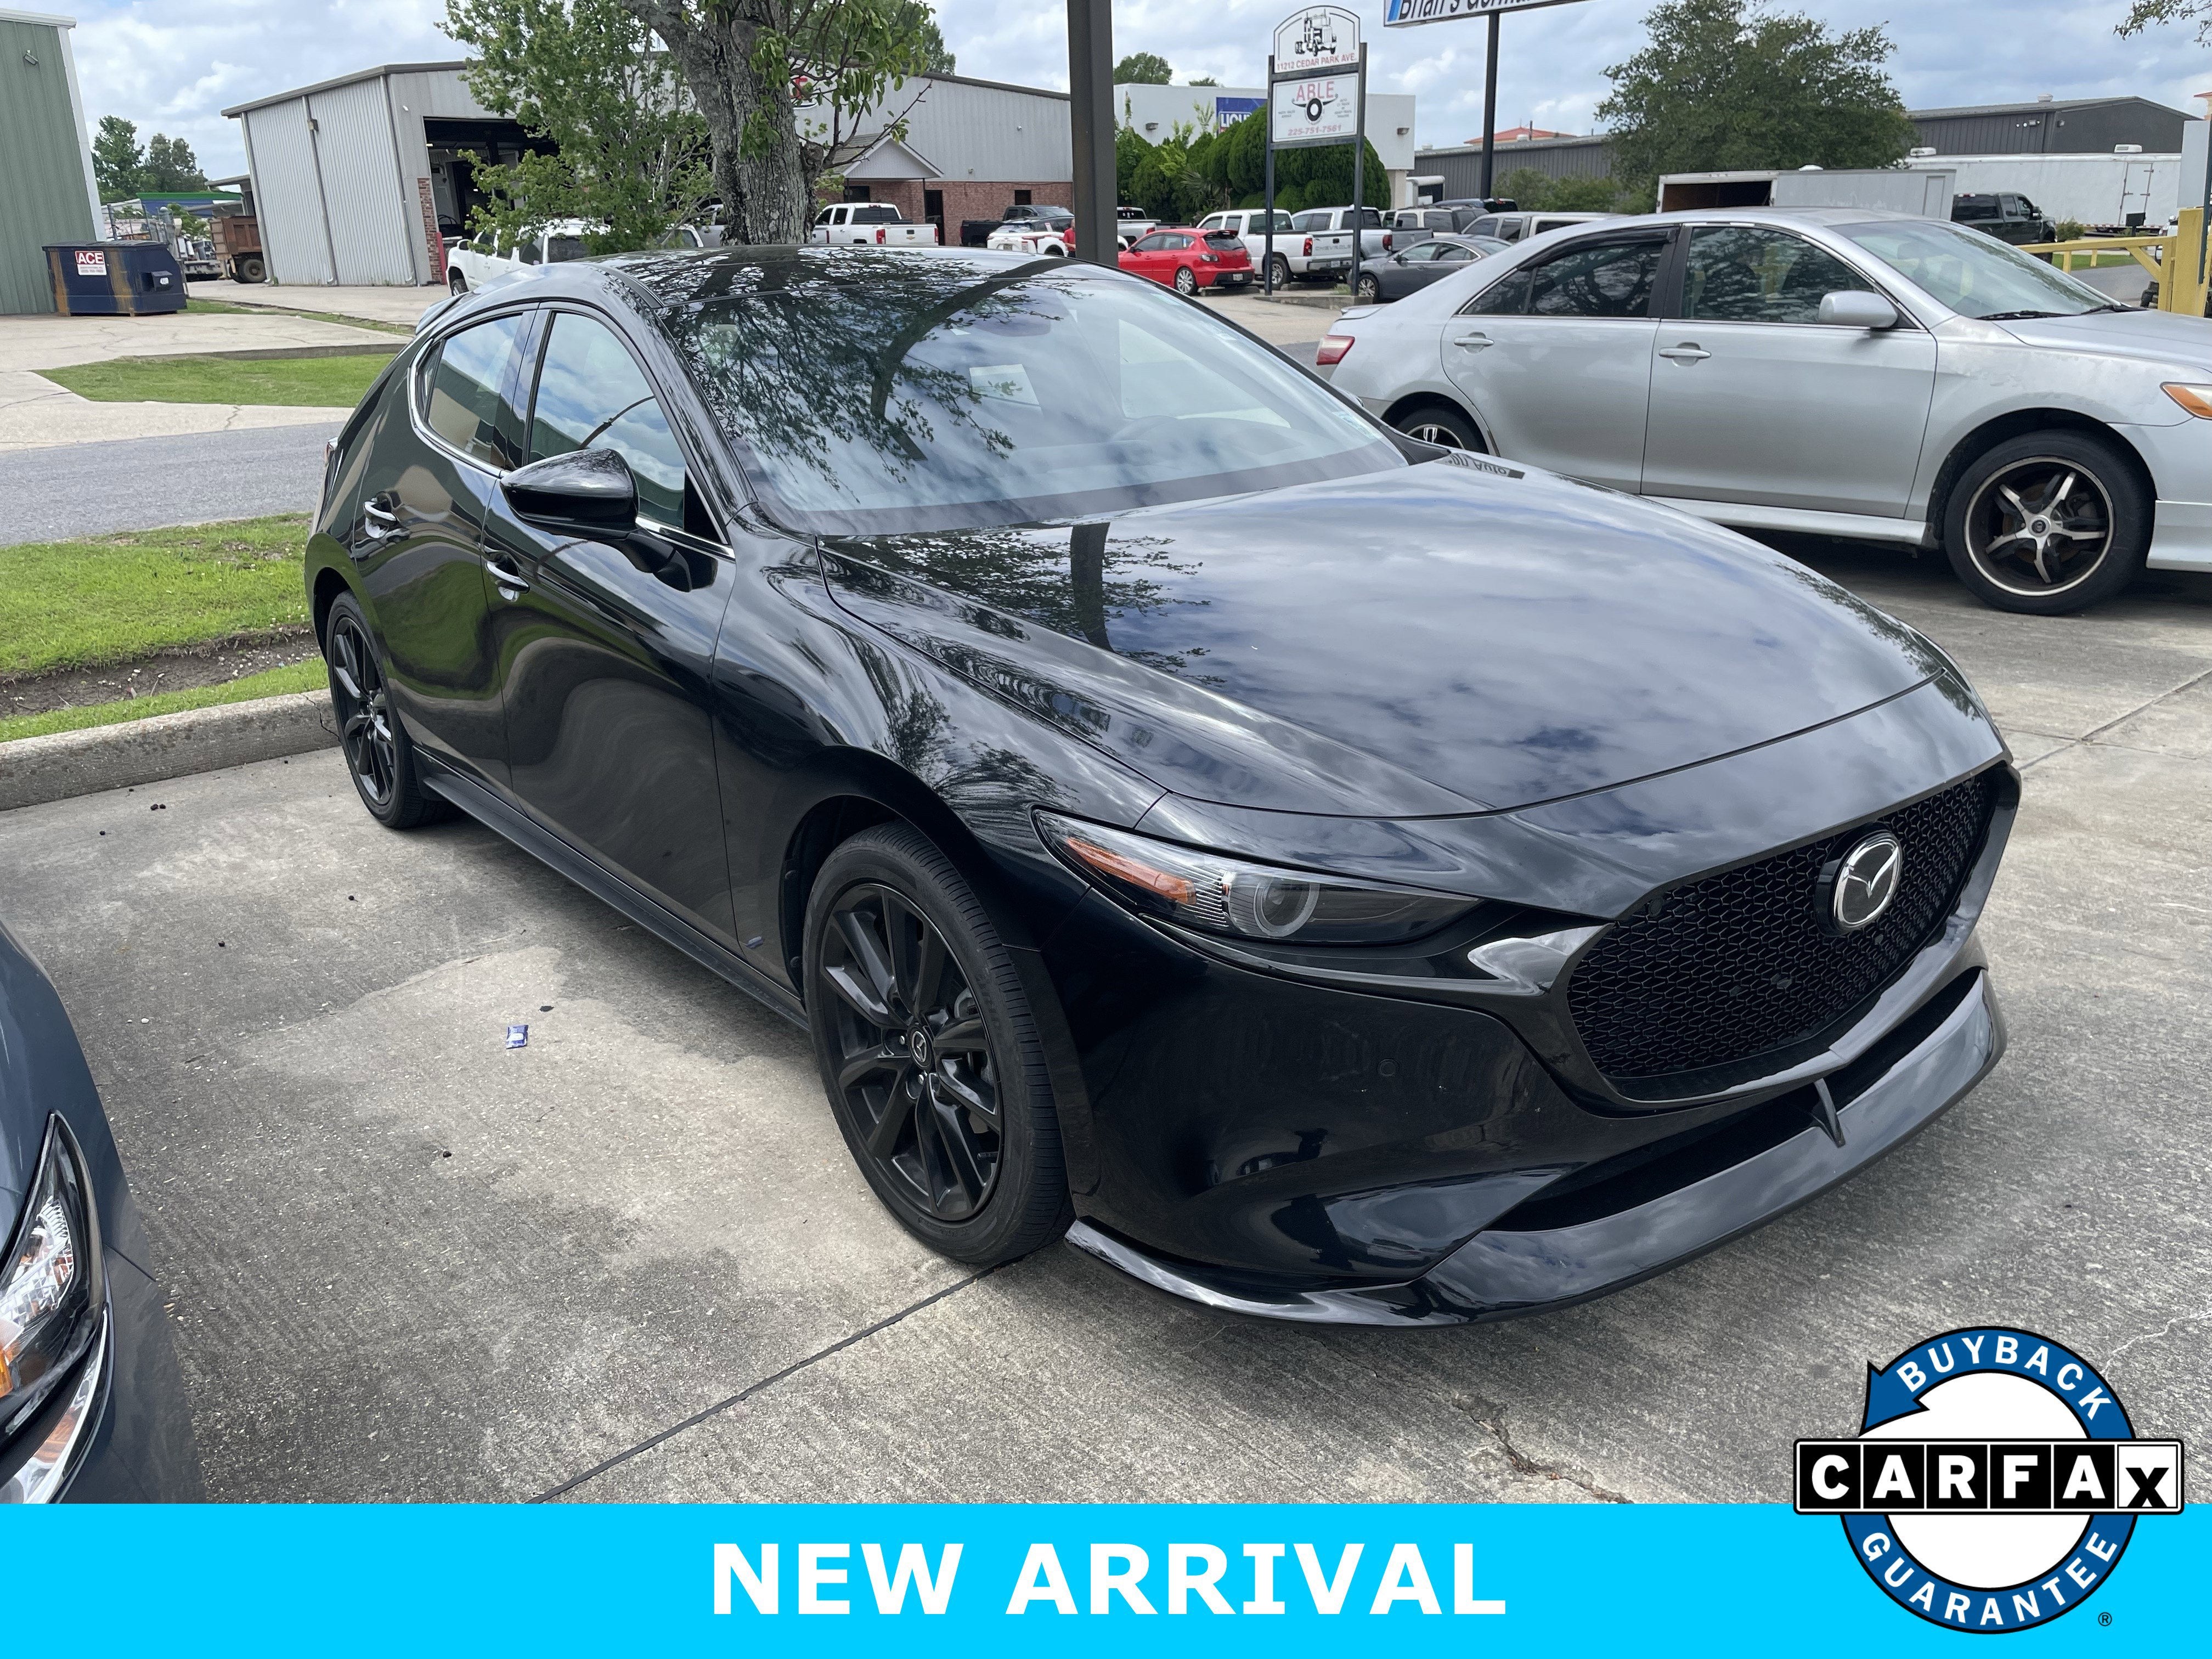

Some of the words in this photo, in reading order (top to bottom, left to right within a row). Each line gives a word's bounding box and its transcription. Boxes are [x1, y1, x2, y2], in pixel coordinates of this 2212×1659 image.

[1296, 58, 1319, 68] CEDAR
[1321, 55, 1339, 65] PARK
[1296, 81, 1334, 102] ABLE
[78, 252, 104, 264] ACE
